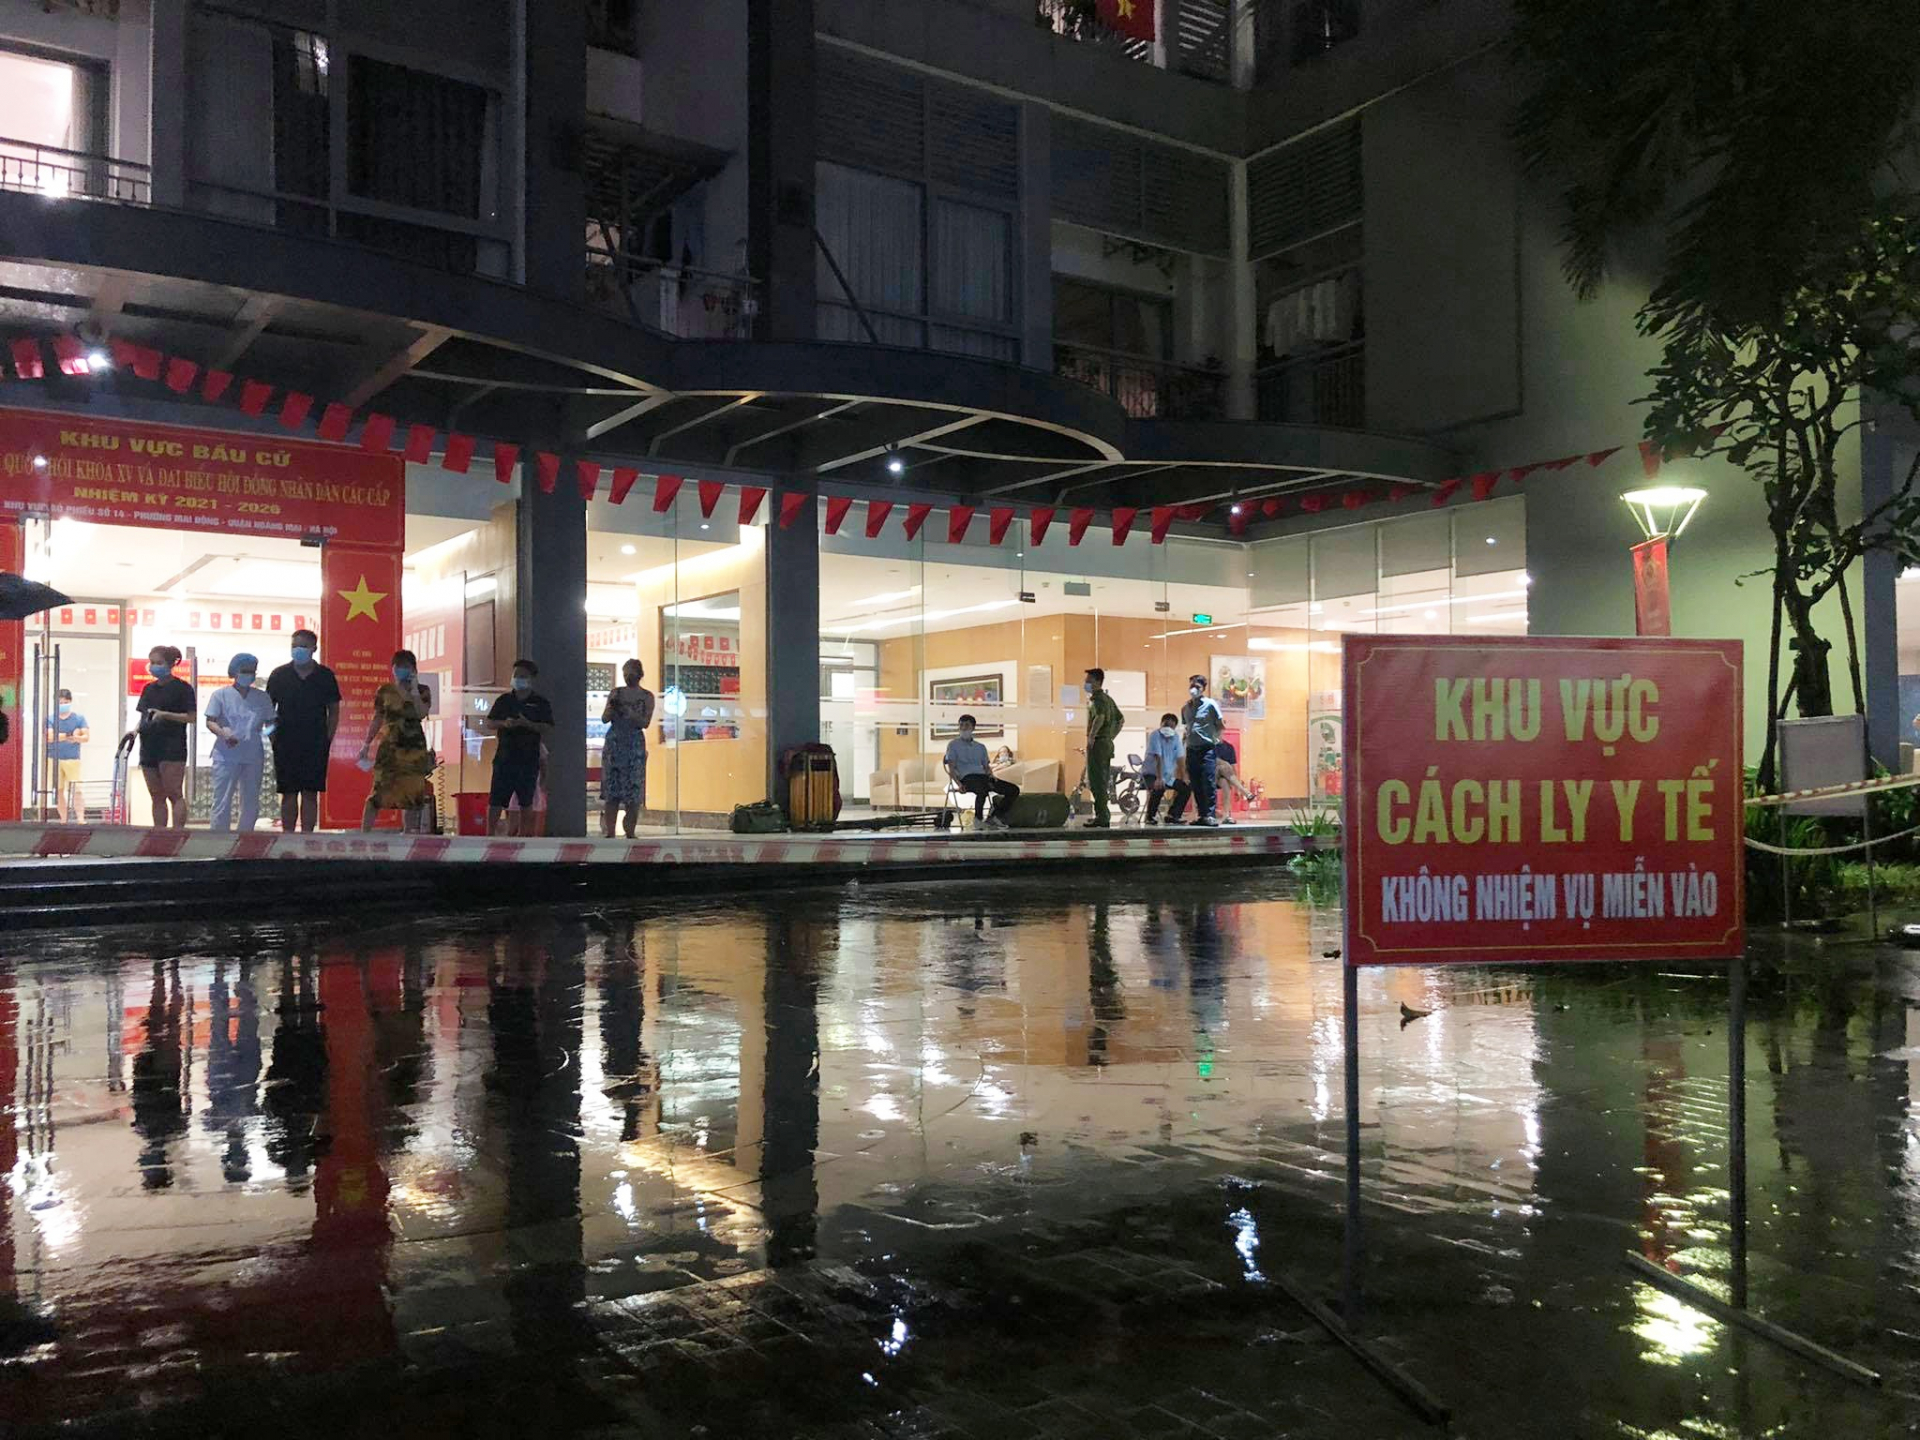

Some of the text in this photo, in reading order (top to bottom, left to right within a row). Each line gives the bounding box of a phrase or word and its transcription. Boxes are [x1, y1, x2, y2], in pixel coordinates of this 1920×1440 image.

[4, 450, 46, 477] QUỐ
[60, 431, 120, 450] KHU
[129, 437, 184, 458] VỰC
[174, 496, 217, 509] 2021
[1435, 673, 1659, 757] KHU VỰC
[1376, 758, 1720, 844] CÁCH LY Y TẾ
[1381, 855, 1718, 931] KHÔNG NHIỆM VỤ MIỄN VÀO
